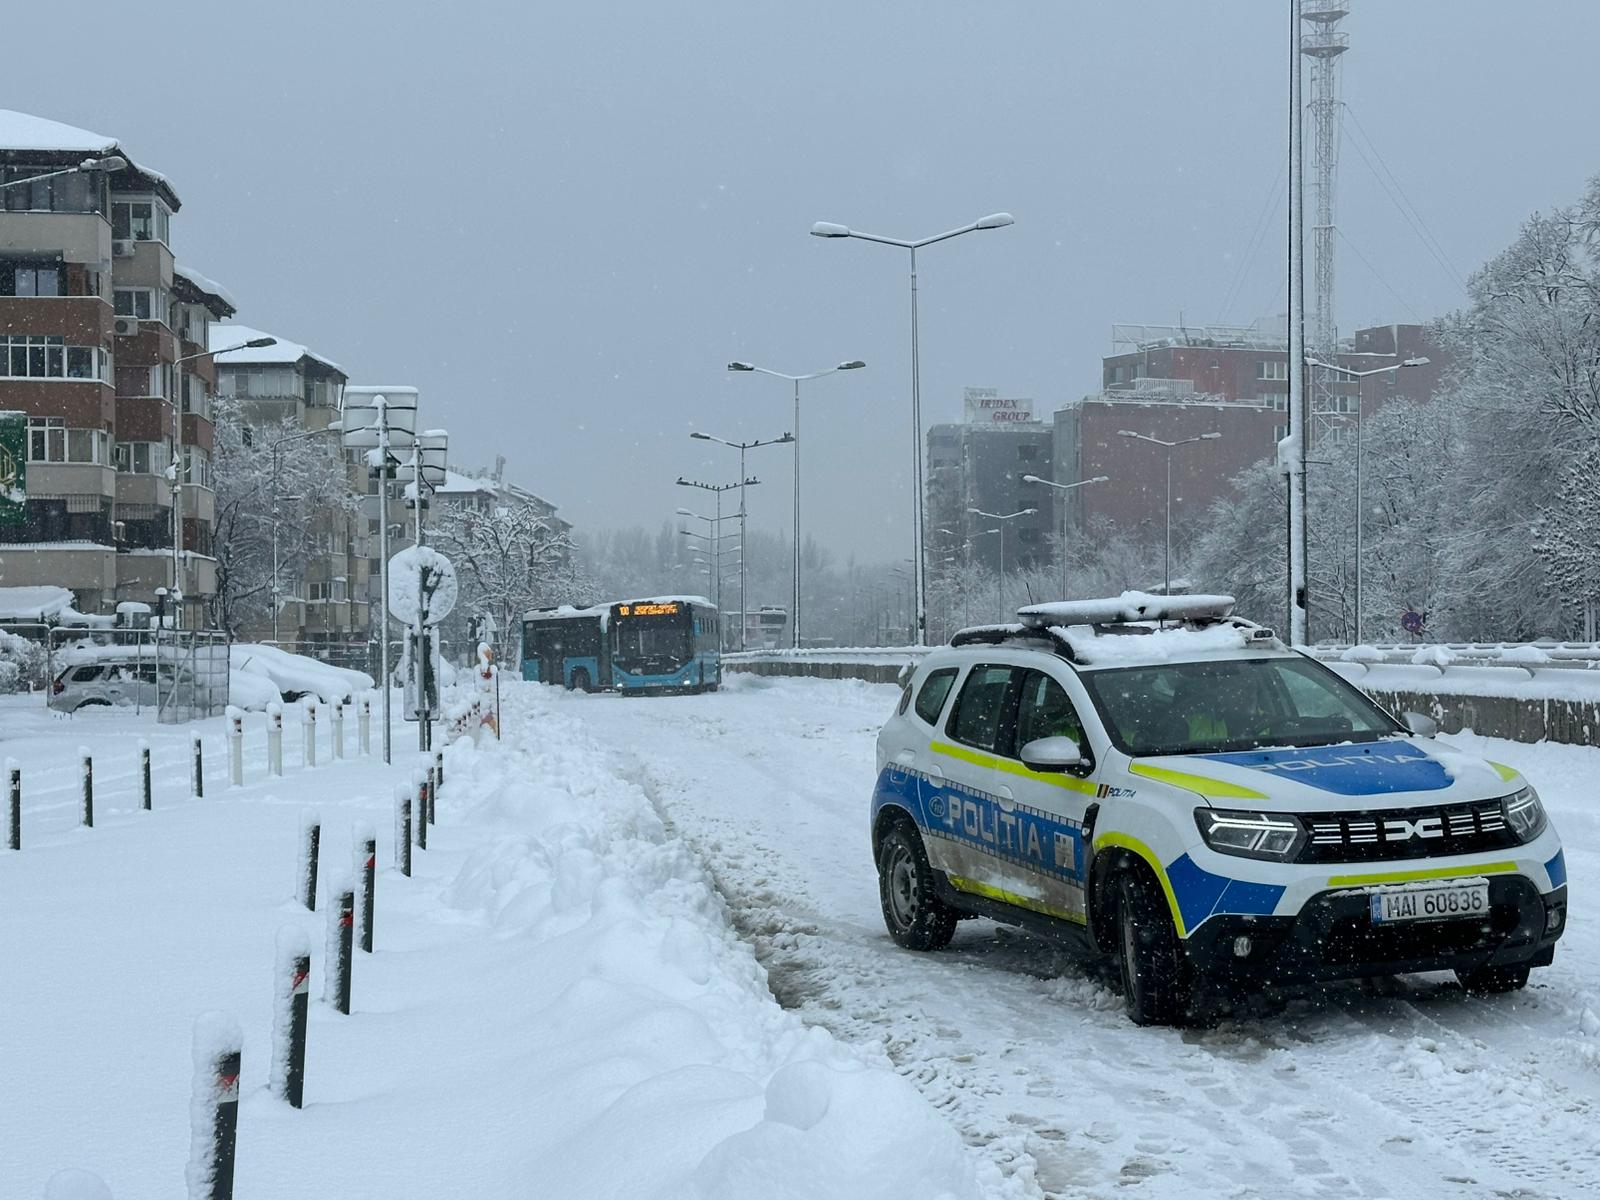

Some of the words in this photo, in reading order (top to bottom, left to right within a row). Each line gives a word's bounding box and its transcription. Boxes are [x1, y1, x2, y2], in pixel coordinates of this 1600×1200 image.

[980, 399, 1018, 409] IRIDEX
[992, 411, 1030, 421] GROUP
[1387, 895, 1417, 918] MAI
[1424, 890, 1483, 915] 60836
